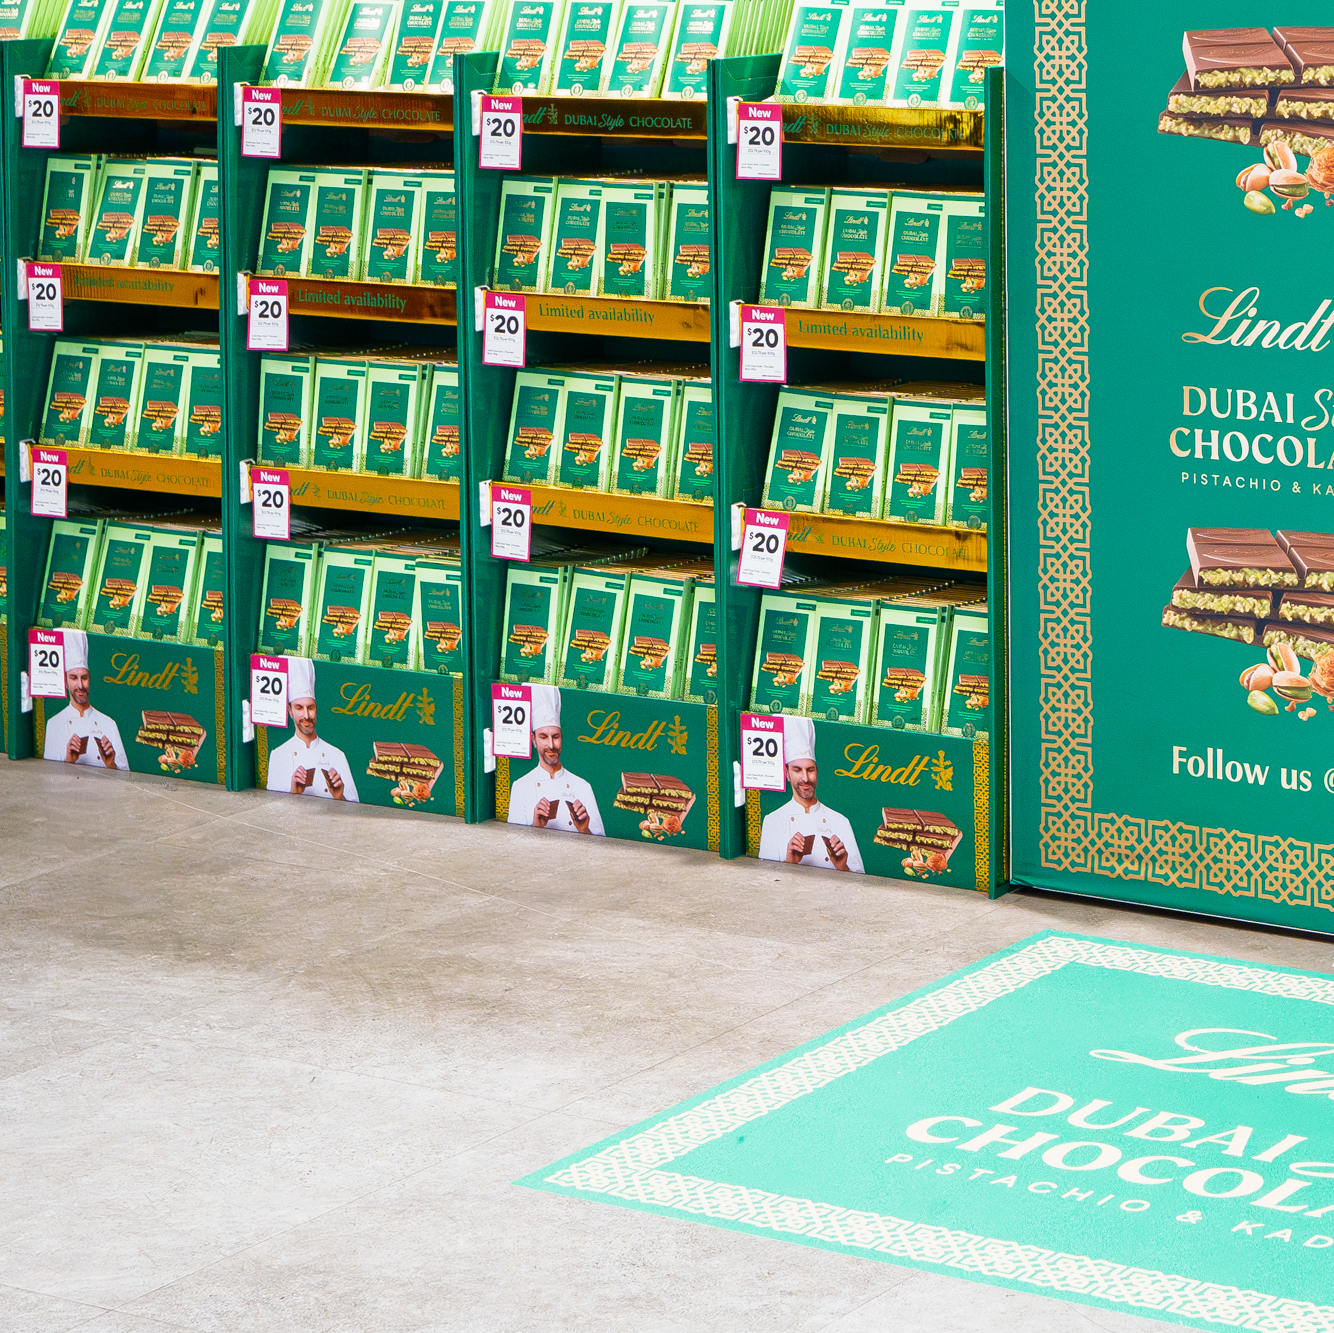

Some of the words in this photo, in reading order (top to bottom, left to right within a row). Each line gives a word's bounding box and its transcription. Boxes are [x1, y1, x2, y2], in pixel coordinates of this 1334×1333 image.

[32, 82, 50, 93] New
[251, 90, 271, 101] New
[28, 100, 53, 117] $20
[491, 100, 511, 111] New
[248, 107, 275, 126] $20
[564, 114, 597, 126] DUBAI
[598, 112, 625, 130] Style
[629, 116, 693, 129] CHOCOLATE
[487, 117, 515, 138] $20
[258, 282, 279, 293] New
[255, 300, 282, 319] $20
[539, 302, 583, 321] Limited
[587, 305, 655, 325] availability
[752, 309, 775, 321] New
[747, 327, 779, 349] $20
[1183, 385, 1294, 423] DUBAI
[1182, 471, 1280, 491] PISTACHIO
[1292, 482, 1301, 493] &
[103, 653, 180, 691] Lindt
[331, 683, 413, 722] Lindt
[577, 709, 666, 752] Lindt
[751, 717, 774, 729] New
[747, 737, 778, 758] $20
[835, 743, 930, 787] Lindt
[1172, 745, 1269, 788] Follow
[1280, 767, 1312, 793] us
[987, 1086, 1308, 1163] DUBAI
[885, 1152, 1152, 1214] PISTACHIO
[1175, 1211, 1203, 1225] &
